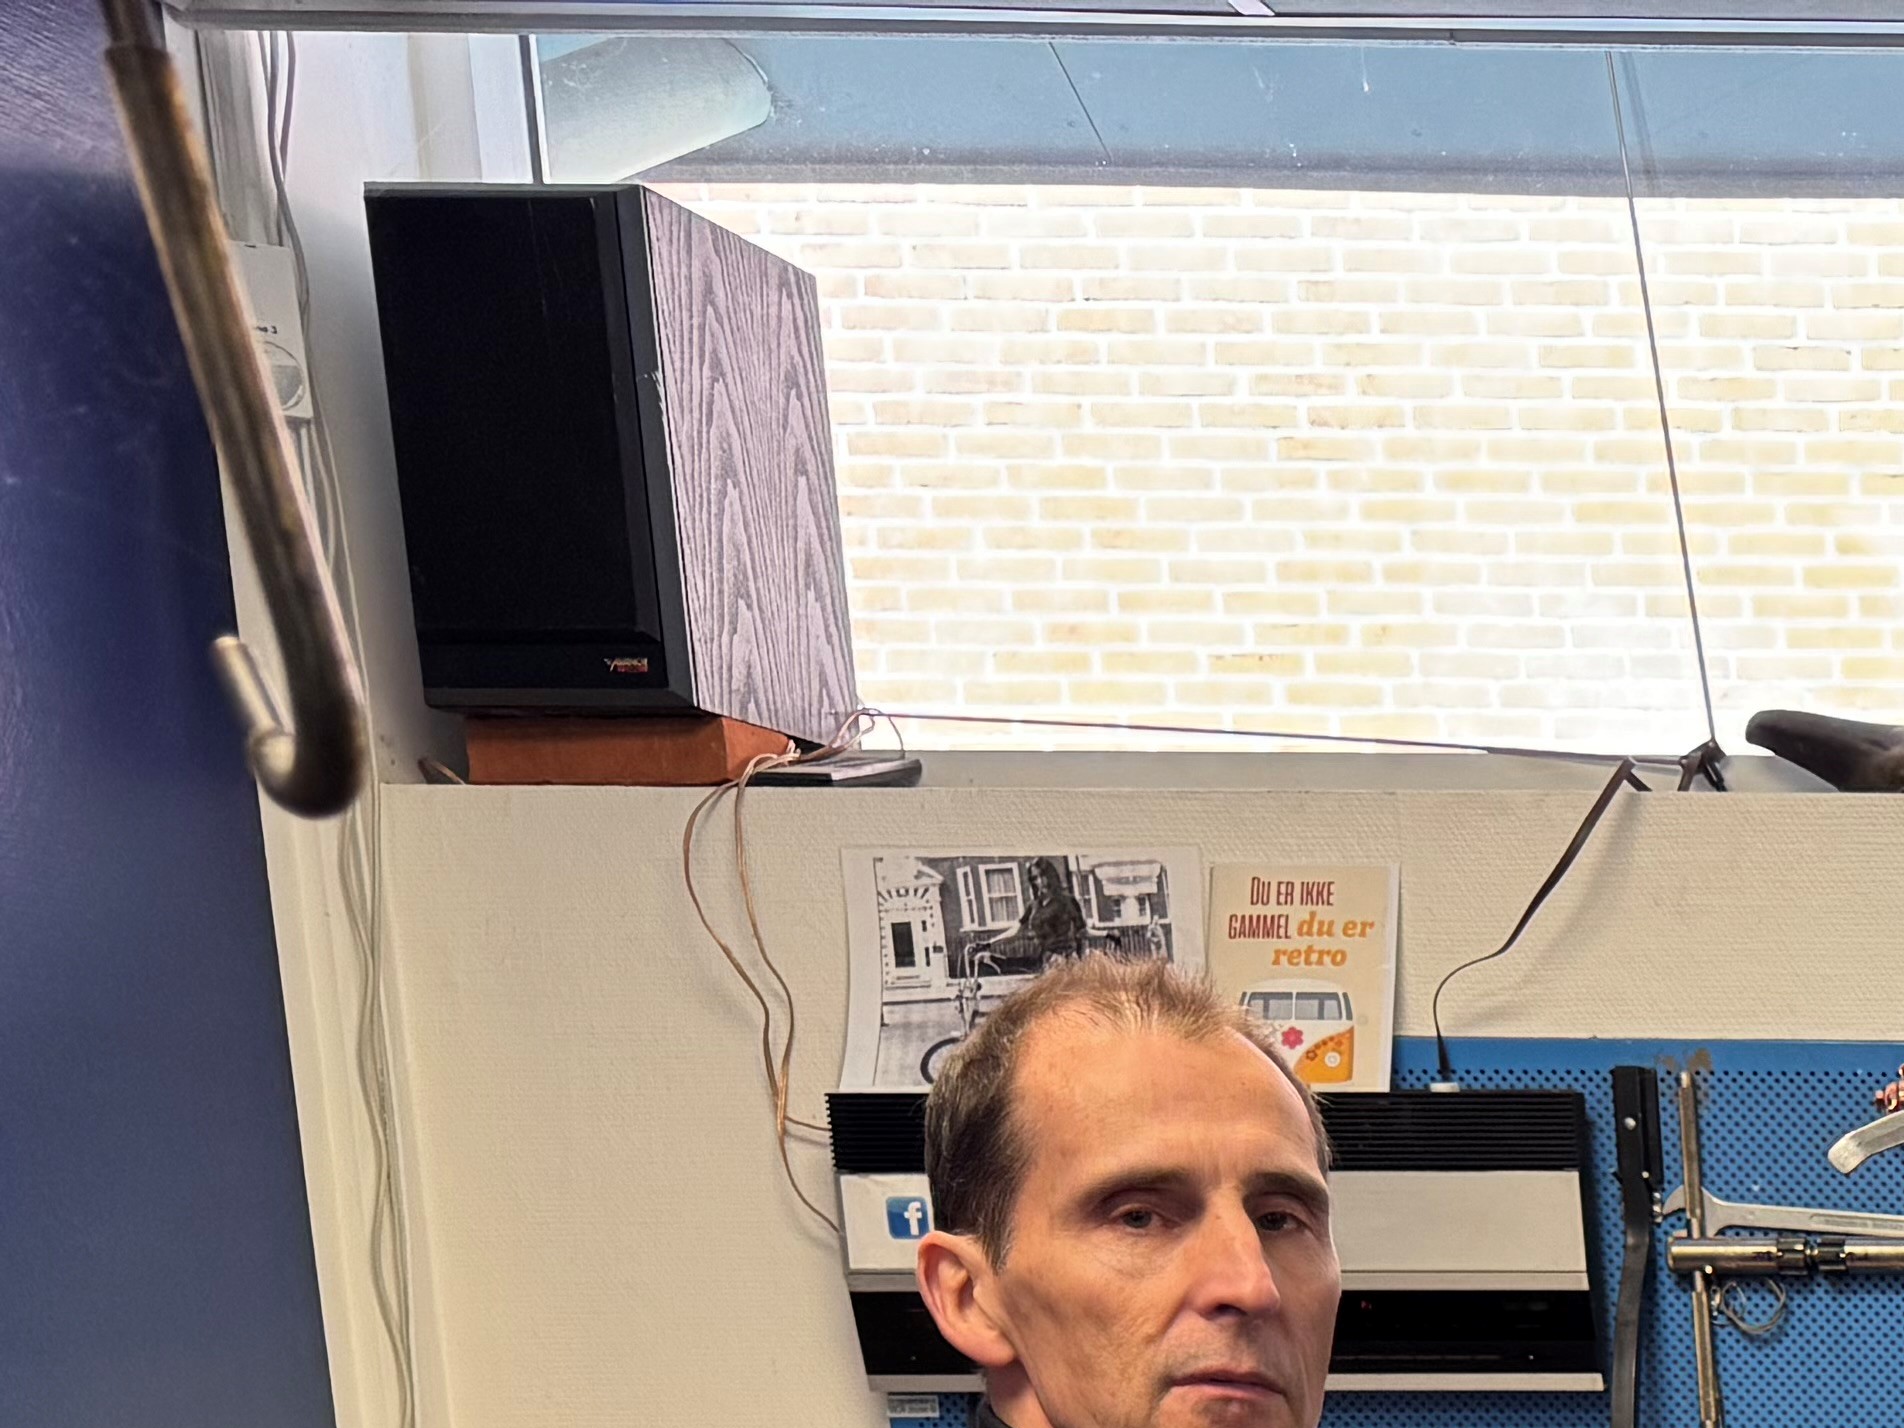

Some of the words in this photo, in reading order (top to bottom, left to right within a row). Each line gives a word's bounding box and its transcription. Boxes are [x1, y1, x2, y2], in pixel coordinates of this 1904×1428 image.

[1276, 881, 1294, 906] ER
[1300, 881, 1335, 906] IKKE
[1228, 914, 1291, 939] GAMMEL
[1297, 911, 1335, 938] du
[1342, 919, 1374, 938] er
[1271, 945, 1347, 966] retro
